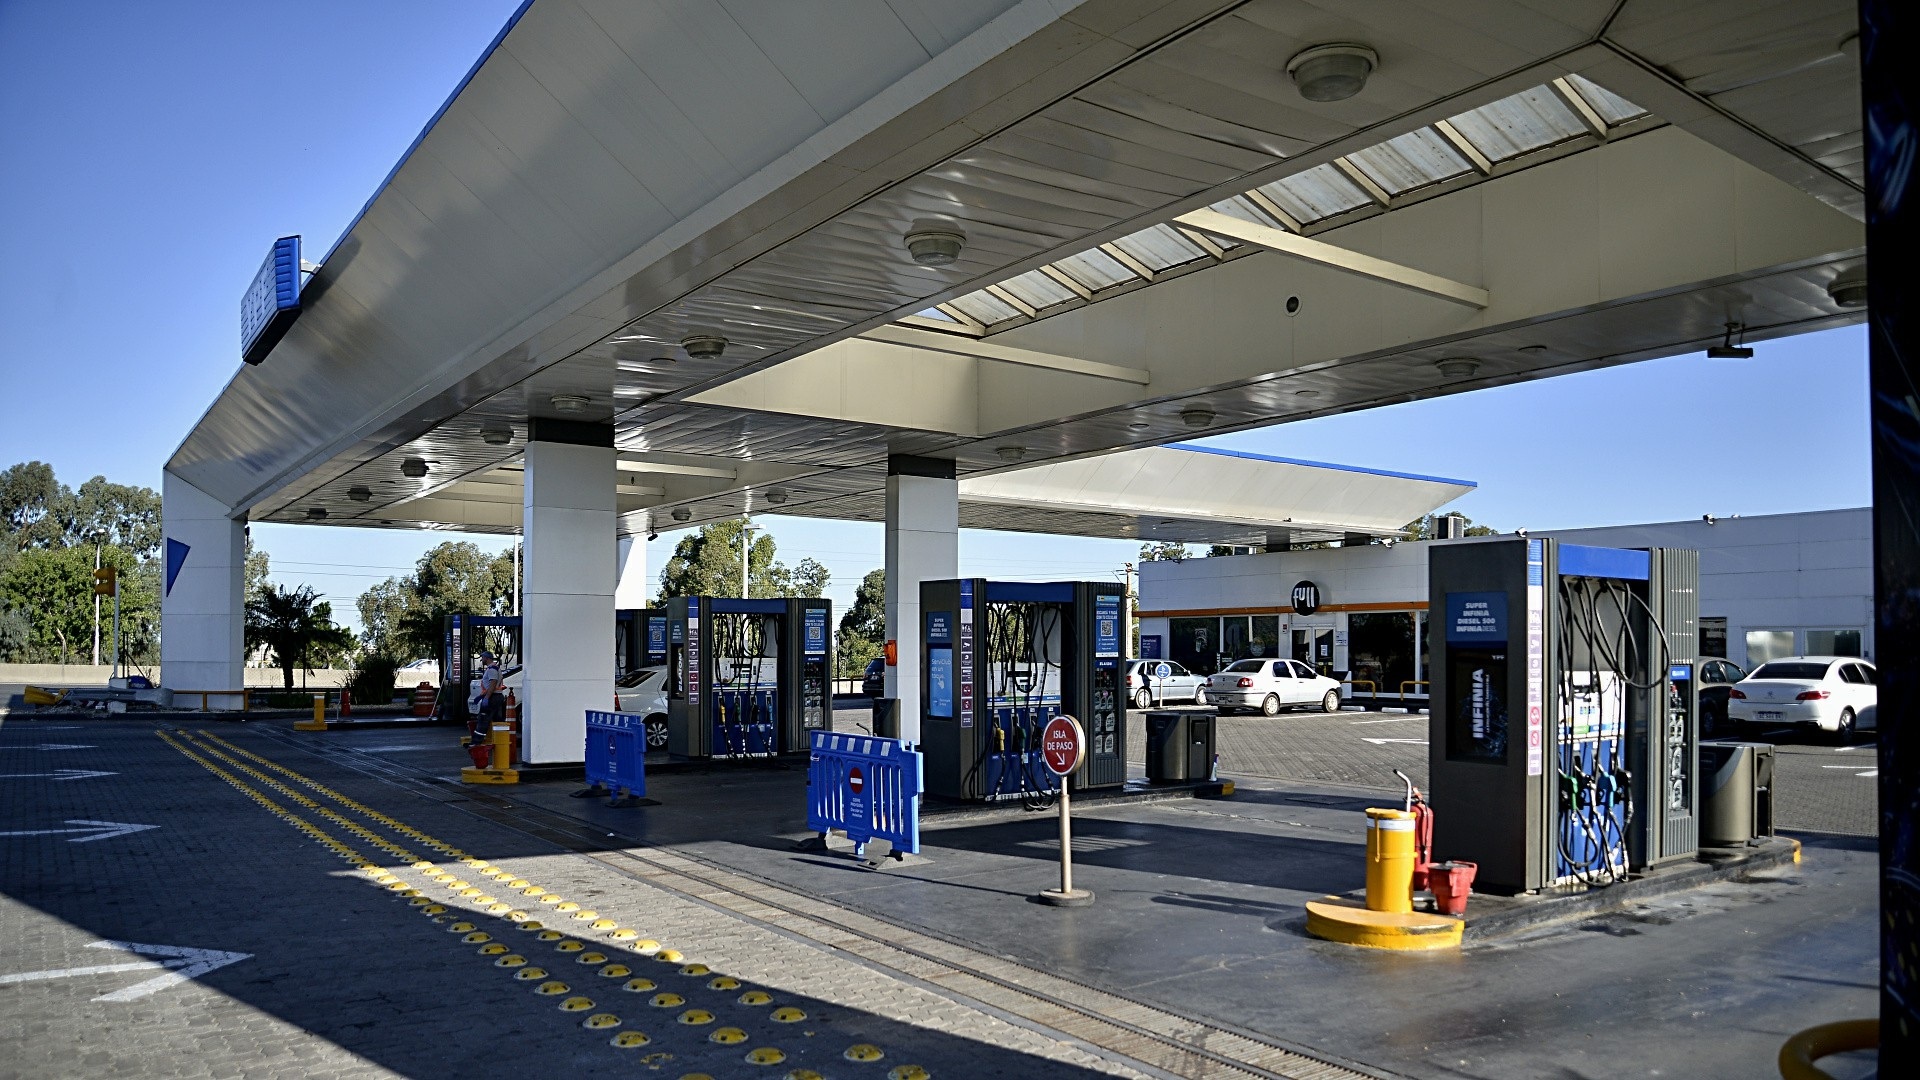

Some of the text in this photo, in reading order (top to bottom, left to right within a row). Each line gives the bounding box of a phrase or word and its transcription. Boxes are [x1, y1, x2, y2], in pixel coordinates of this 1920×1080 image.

[1293, 586, 1315, 608] full
[1472, 668, 1483, 738] INFINIA
[1053, 730, 1067, 739] ISLA
[1047, 741, 1074, 751] DE PASO
